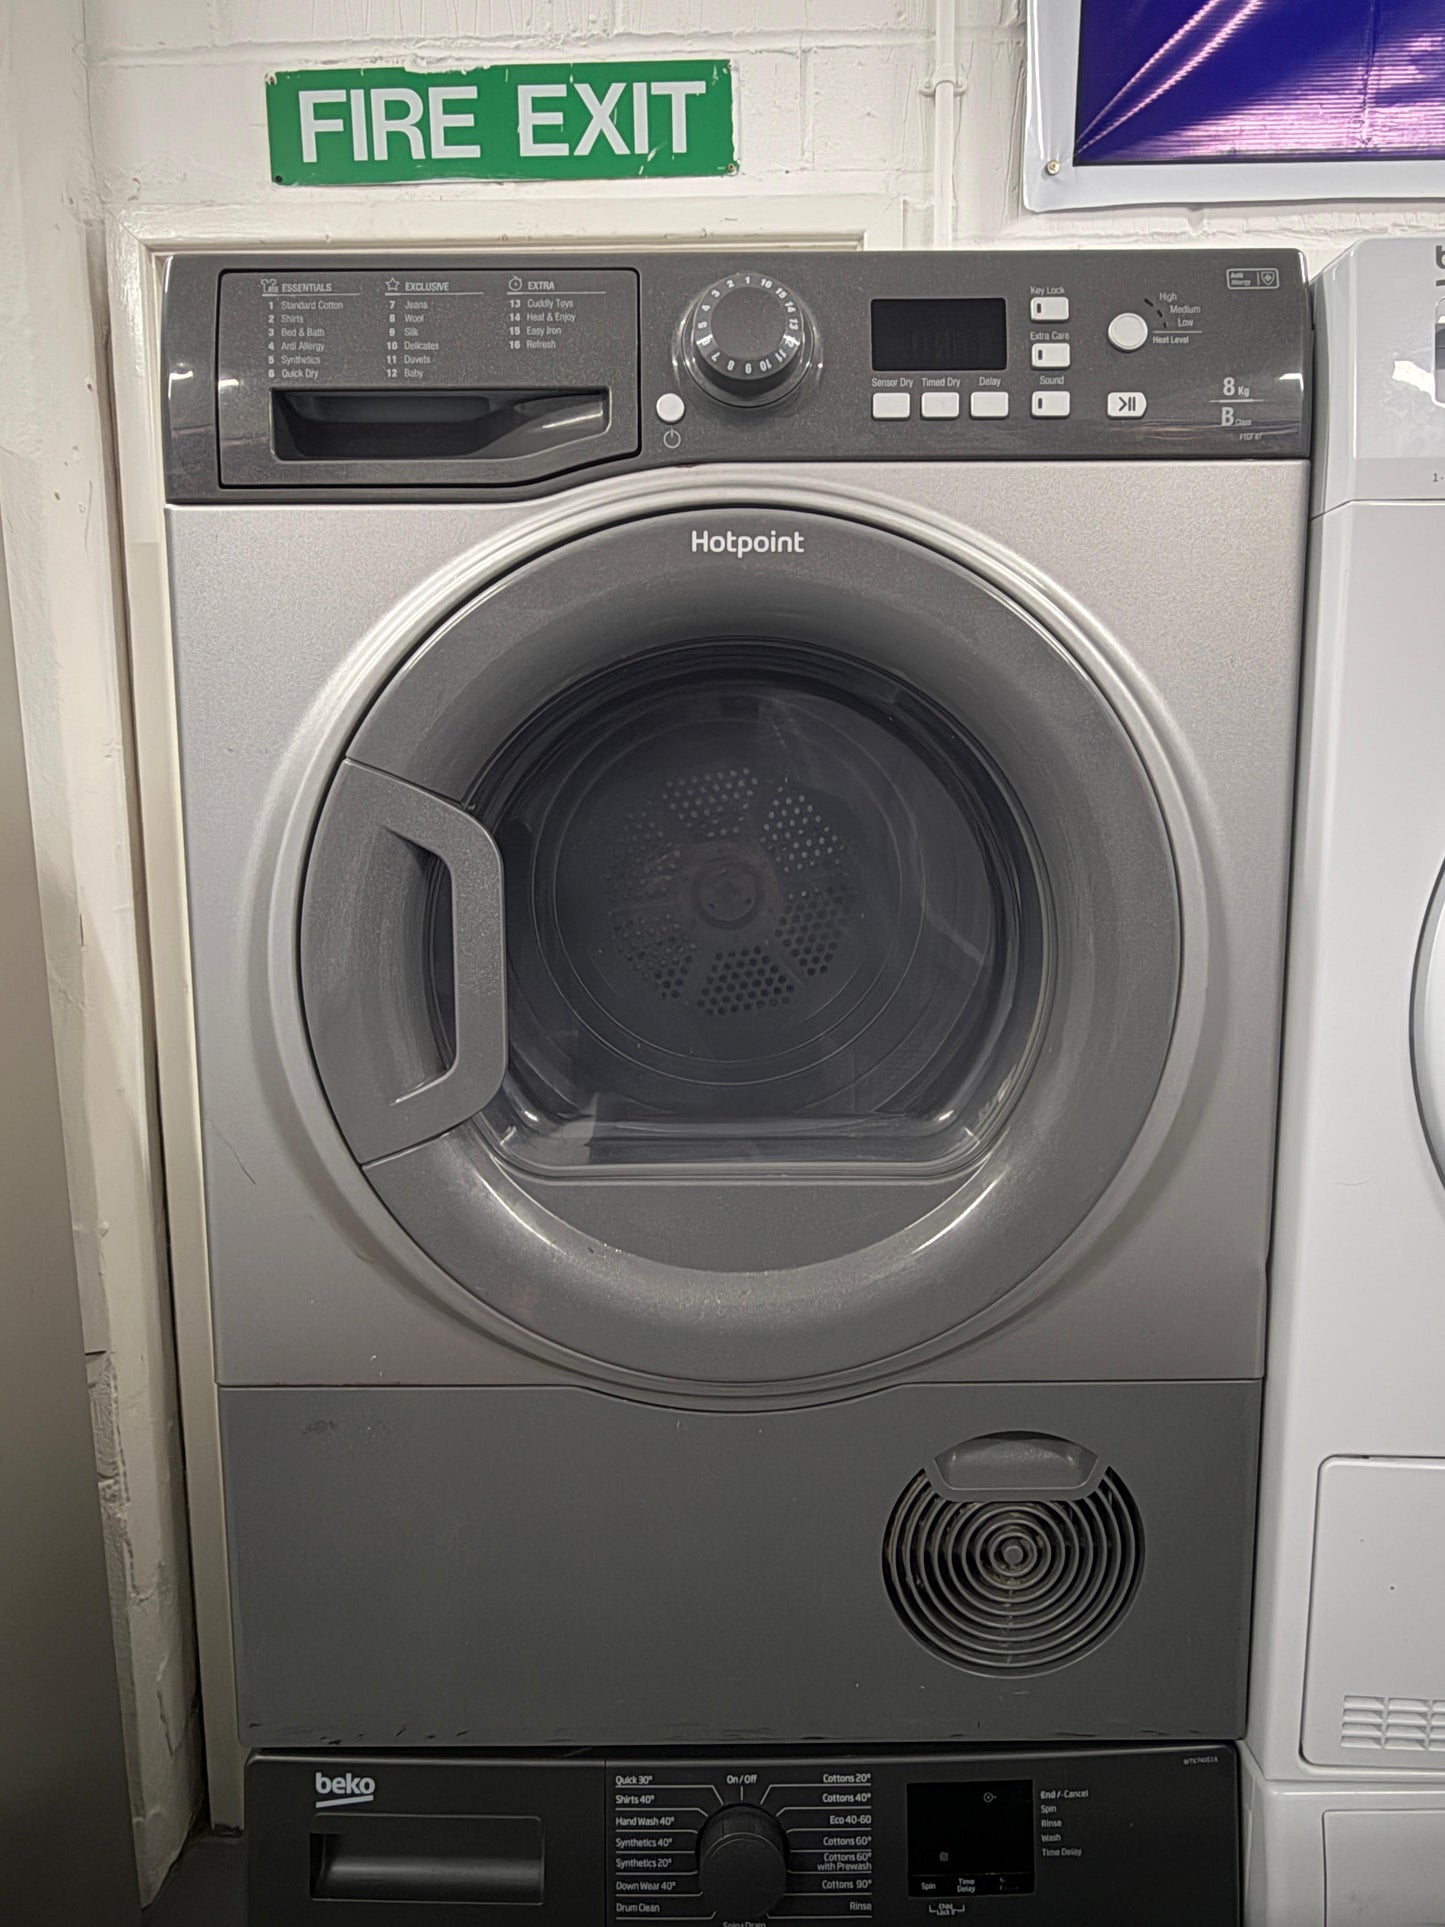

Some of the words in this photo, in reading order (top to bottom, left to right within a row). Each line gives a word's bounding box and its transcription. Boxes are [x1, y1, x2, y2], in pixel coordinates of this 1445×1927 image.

[299, 86, 481, 163] FIRE
[517, 81, 706, 157] EXIT
[726, 279, 735, 288] 2
[745, 276, 750, 284] 1
[760, 278, 773, 289] 16
[281, 283, 332, 292] ESSENTIALS
[405, 282, 449, 292] EXCLUSIVE
[528, 281, 555, 290] EXTRA
[711, 289, 720, 298] 3
[775, 287, 788, 299] 15
[1030, 286, 1045, 296] Key
[1047, 286, 1065, 294] Lock
[1159, 292, 1177, 302] High
[268, 301, 274, 310] 1
[281, 301, 316, 310] Standard
[318, 301, 344, 310] Cotton
[389, 300, 395, 309] 7
[404, 300, 428, 309] Jeans
[510, 299, 521, 308] 13
[527, 299, 553, 309] Cuddly
[556, 299, 574, 309] Toys
[701, 304, 711, 312] 4
[784, 301, 796, 313] 14
[1170, 305, 1200, 314] Medium
[268, 315, 274, 323] 2
[281, 314, 304, 324] Shirts
[404, 314, 424, 323] Wool
[509, 313, 521, 322] 14
[526, 313, 545, 322] Heat
[546, 313, 553, 322] &
[555, 312, 576, 323] Enjoy
[698, 321, 707, 329] 5
[788, 318, 799, 330] 13
[1178, 319, 1193, 327] Low
[268, 328, 274, 337] 3
[281, 328, 297, 337] Bed
[298, 328, 305, 337] &
[307, 327, 325, 337] Bath
[404, 328, 419, 336] Silk
[509, 327, 521, 335] 15
[526, 326, 544, 337] Easy
[546, 326, 562, 335] Iron
[1030, 332, 1050, 341] Extra
[1051, 331, 1070, 340] Care
[509, 340, 521, 349] 16
[526, 340, 556, 349] Refresh
[1153, 336, 1169, 344] Heat
[1171, 335, 1189, 344] Level
[268, 342, 274, 350] 4
[281, 342, 297, 350] Anti
[299, 341, 325, 352] Allergy
[387, 341, 398, 350] 10
[404, 341, 440, 350] Delicates
[268, 356, 274, 364] 5
[281, 355, 321, 365] Synthetics
[386, 355, 397, 364] 11
[404, 355, 431, 364] Duvets
[711, 351, 721, 362] 7
[774, 349, 787, 363] 11
[727, 360, 735, 371] 8
[759, 358, 773, 372] 10
[281, 369, 304, 378] Quick
[306, 369, 319, 379] Dry
[386, 369, 398, 378] 12
[404, 369, 423, 379] Baby
[871, 378, 898, 387] Sensor
[900, 378, 913, 388] Dry
[921, 377, 945, 387] Timed
[947, 377, 961, 388] Dry
[979, 376, 1002, 387] Delay
[1040, 376, 1065, 385] Sound
[1223, 377, 1235, 396] 8
[1238, 386, 1250, 398] Kg
[1221, 407, 1234, 426] B
[691, 530, 805, 558] Hotpoint
[315, 1772, 376, 1794] beko
[615, 1775, 637, 1786] Quick
[726, 1775, 738, 1784] On
[744, 1774, 758, 1784] Off
[822, 1773, 855, 1783] Cottons
[615, 1795, 639, 1804] Shirts
[822, 1793, 855, 1803] Cottons
[1040, 1790, 1056, 1799] End
[1040, 1805, 1057, 1814] Spin
[615, 1816, 637, 1826] Hand
[638, 1816, 659, 1826] Wash
[829, 1815, 845, 1825] Eco
[845, 1815, 872, 1824] 40-60
[1041, 1819, 1063, 1828] Rinse
[823, 1836, 855, 1846] Cottons
[1041, 1834, 1062, 1842] Wash
[615, 1838, 657, 1849] Synthetics
[823, 1853, 856, 1862] Cottons
[1042, 1848, 1060, 1857] Time
[1061, 1848, 1082, 1857] Delay
[615, 1858, 657, 1870] Synthetics
[817, 1862, 836, 1871] with
[836, 1862, 872, 1871] Prewash
[616, 1881, 640, 1891] Down
[640, 1881, 660, 1891] Wear
[821, 1879, 854, 1889] Cottons
[921, 1882, 936, 1891] Spin
[616, 1903, 638, 1912] Drum
[638, 1903, 660, 1912] Clean
[849, 1901, 872, 1911] Rinse
